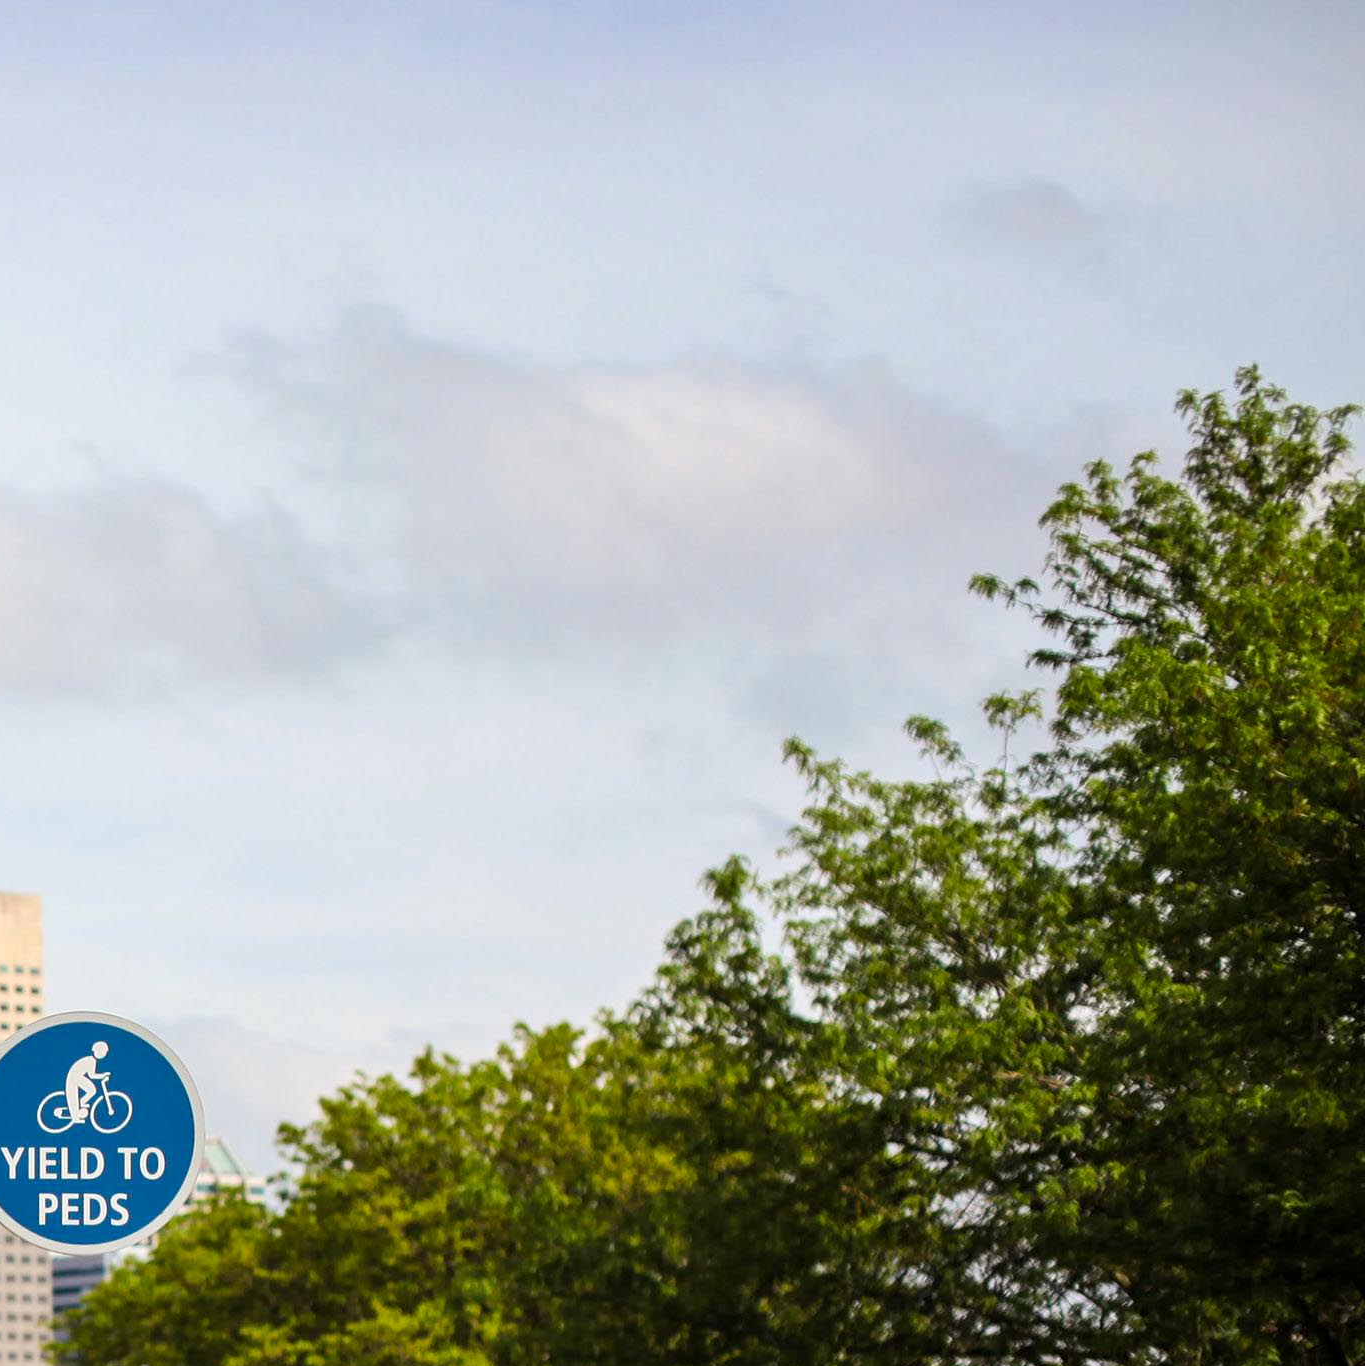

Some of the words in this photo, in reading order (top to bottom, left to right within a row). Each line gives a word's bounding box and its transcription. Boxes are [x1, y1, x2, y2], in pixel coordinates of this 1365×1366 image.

[0, 1146, 105, 1180] YIELD
[117, 1146, 166, 1181] TO
[38, 1192, 130, 1226] PEDS
